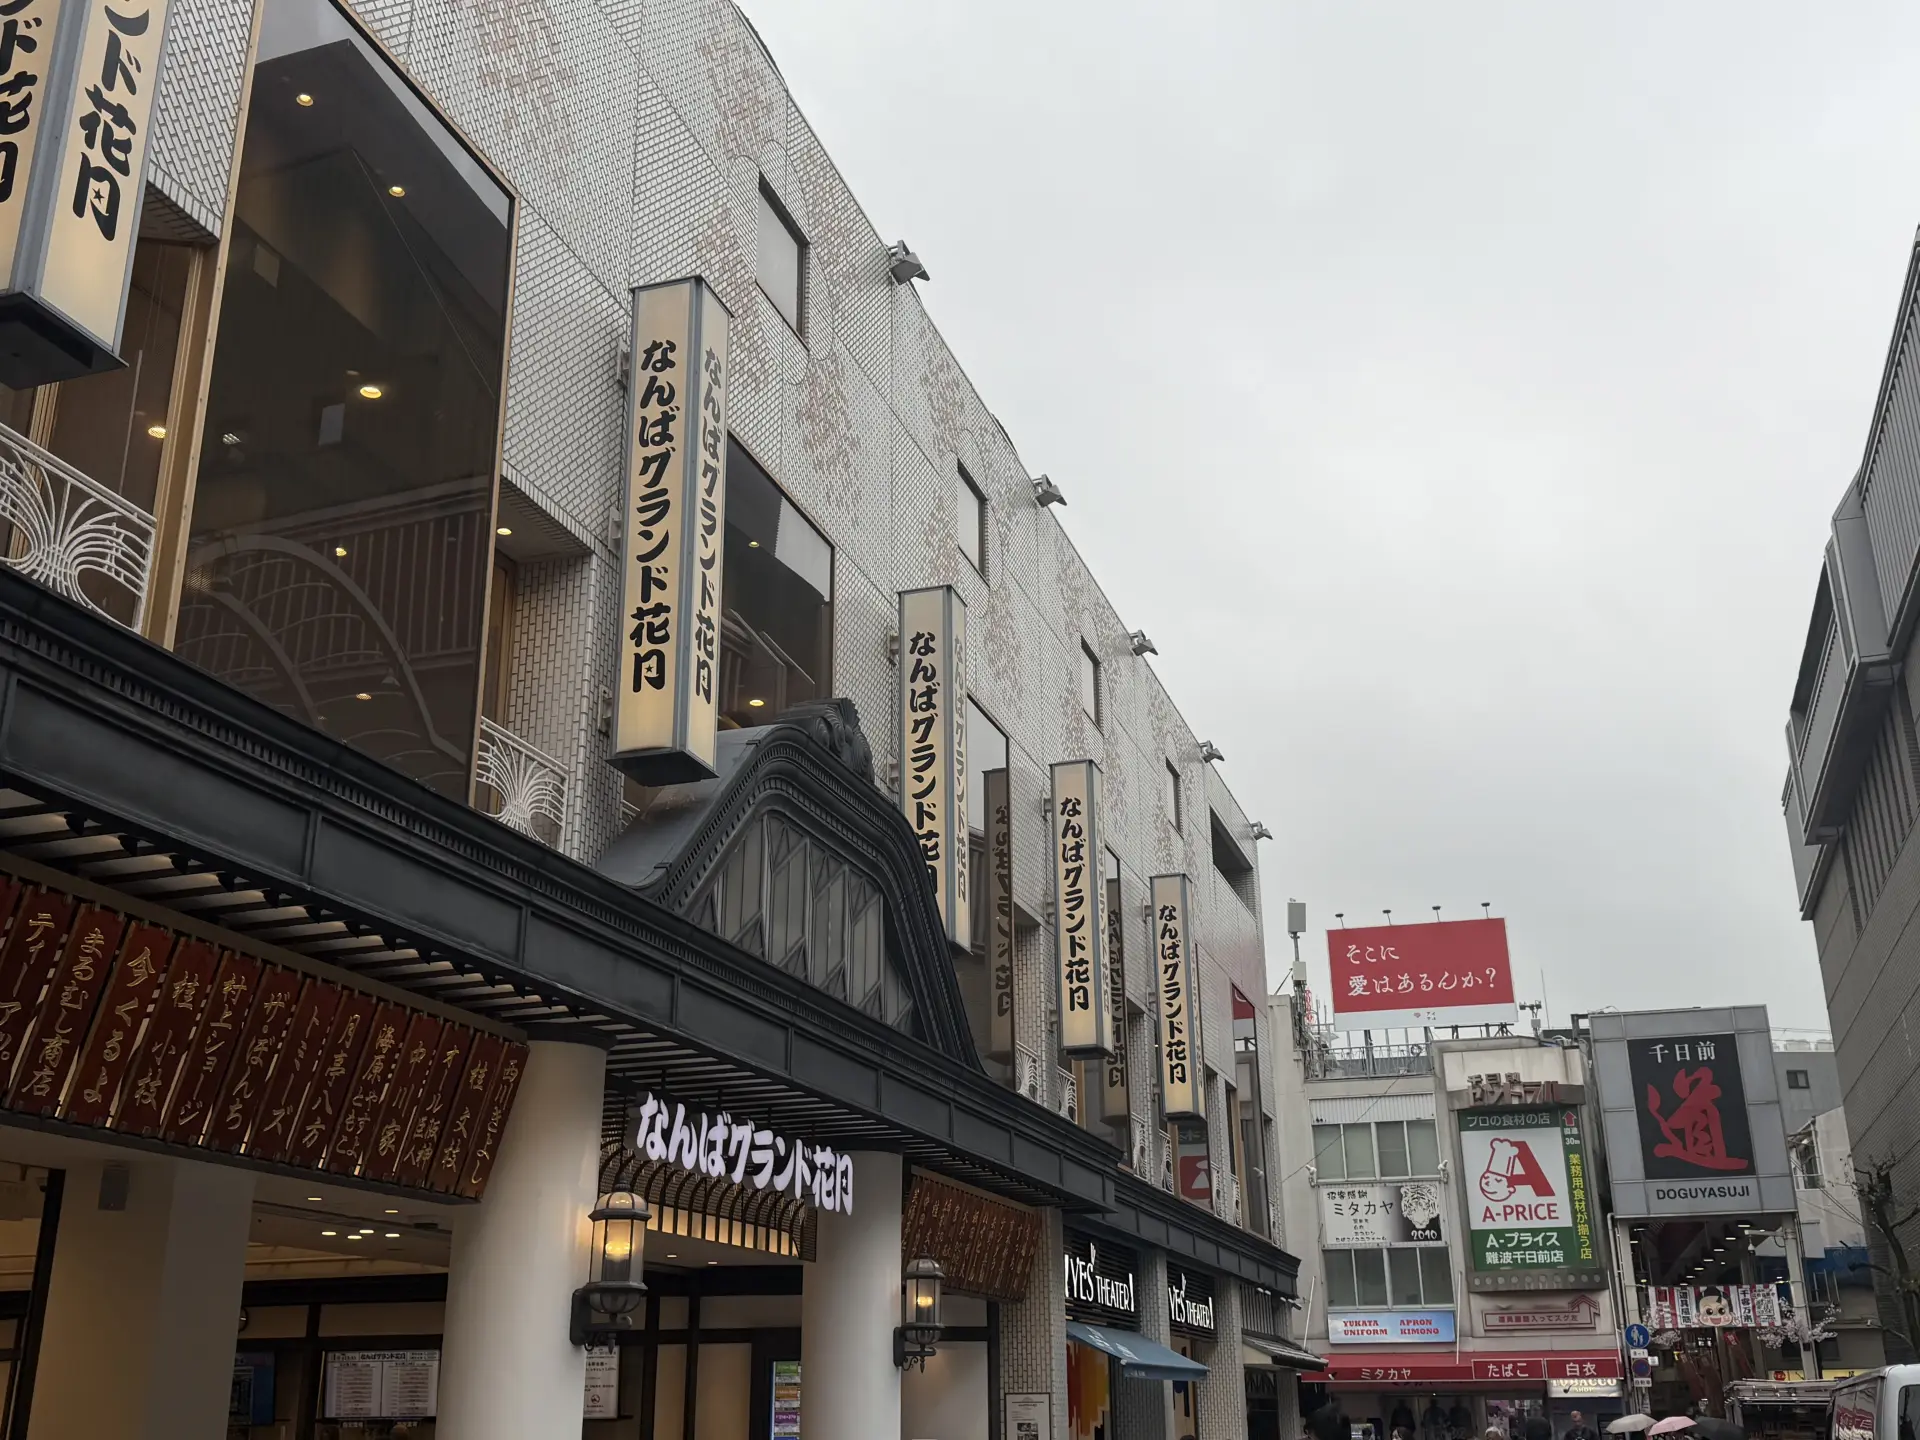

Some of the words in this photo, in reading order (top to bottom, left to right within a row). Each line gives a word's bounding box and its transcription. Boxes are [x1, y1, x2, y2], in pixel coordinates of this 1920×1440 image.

[630, 338, 679, 694] なんばグランド花月
[694, 345, 724, 705] なんばグランド花月
[1060, 796, 1091, 1013] なんばグランド花月
[1346, 944, 1400, 965] そこに
[1347, 966, 1498, 997] 愛はあるんか?
[22, 928, 104, 1097] まるむし商店
[1157, 903, 1187, 1085] なんばグランド花月
[84, 947, 156, 1104] 今くるよ
[179, 973, 248, 1126] 村上ショージ
[1648, 1041, 1716, 1063] 千日前
[263, 1005, 320, 1136] トミーズ
[302, 1014, 361, 1148] 月亭八方
[378, 1040, 427, 1157] 中川家
[471, 1059, 519, 1184] 西川きよし
[1467, 1112, 1550, 1128] プロの食材の店
[1647, 1066, 1749, 1171] 道
[636, 1091, 854, 1216] なんばグランド花月
[1333, 1200, 1394, 1216] ミタカヤ
[1482, 1203, 1560, 1223] A-PRICE
[1568, 1153, 1593, 1260] 業務用食材が揃う店
[1656, 1185, 1750, 1200] DOGUYASUJI
[1485, 1250, 1564, 1265] 難波千日前店
[1486, 1231, 1561, 1249] A-プライス
[1070, 1255, 1095, 1302] YES
[1095, 1275, 1131, 1312] THEATER
[1168, 1286, 1187, 1323] YES
[1186, 1300, 1211, 1329] THEATER
[1343, 1328, 1388, 1336] UNIFORM
[1361, 1368, 1411, 1380] ミタカヤ
[1487, 1363, 1529, 1378] たばこ
[1566, 1362, 1597, 1377] 白衣
